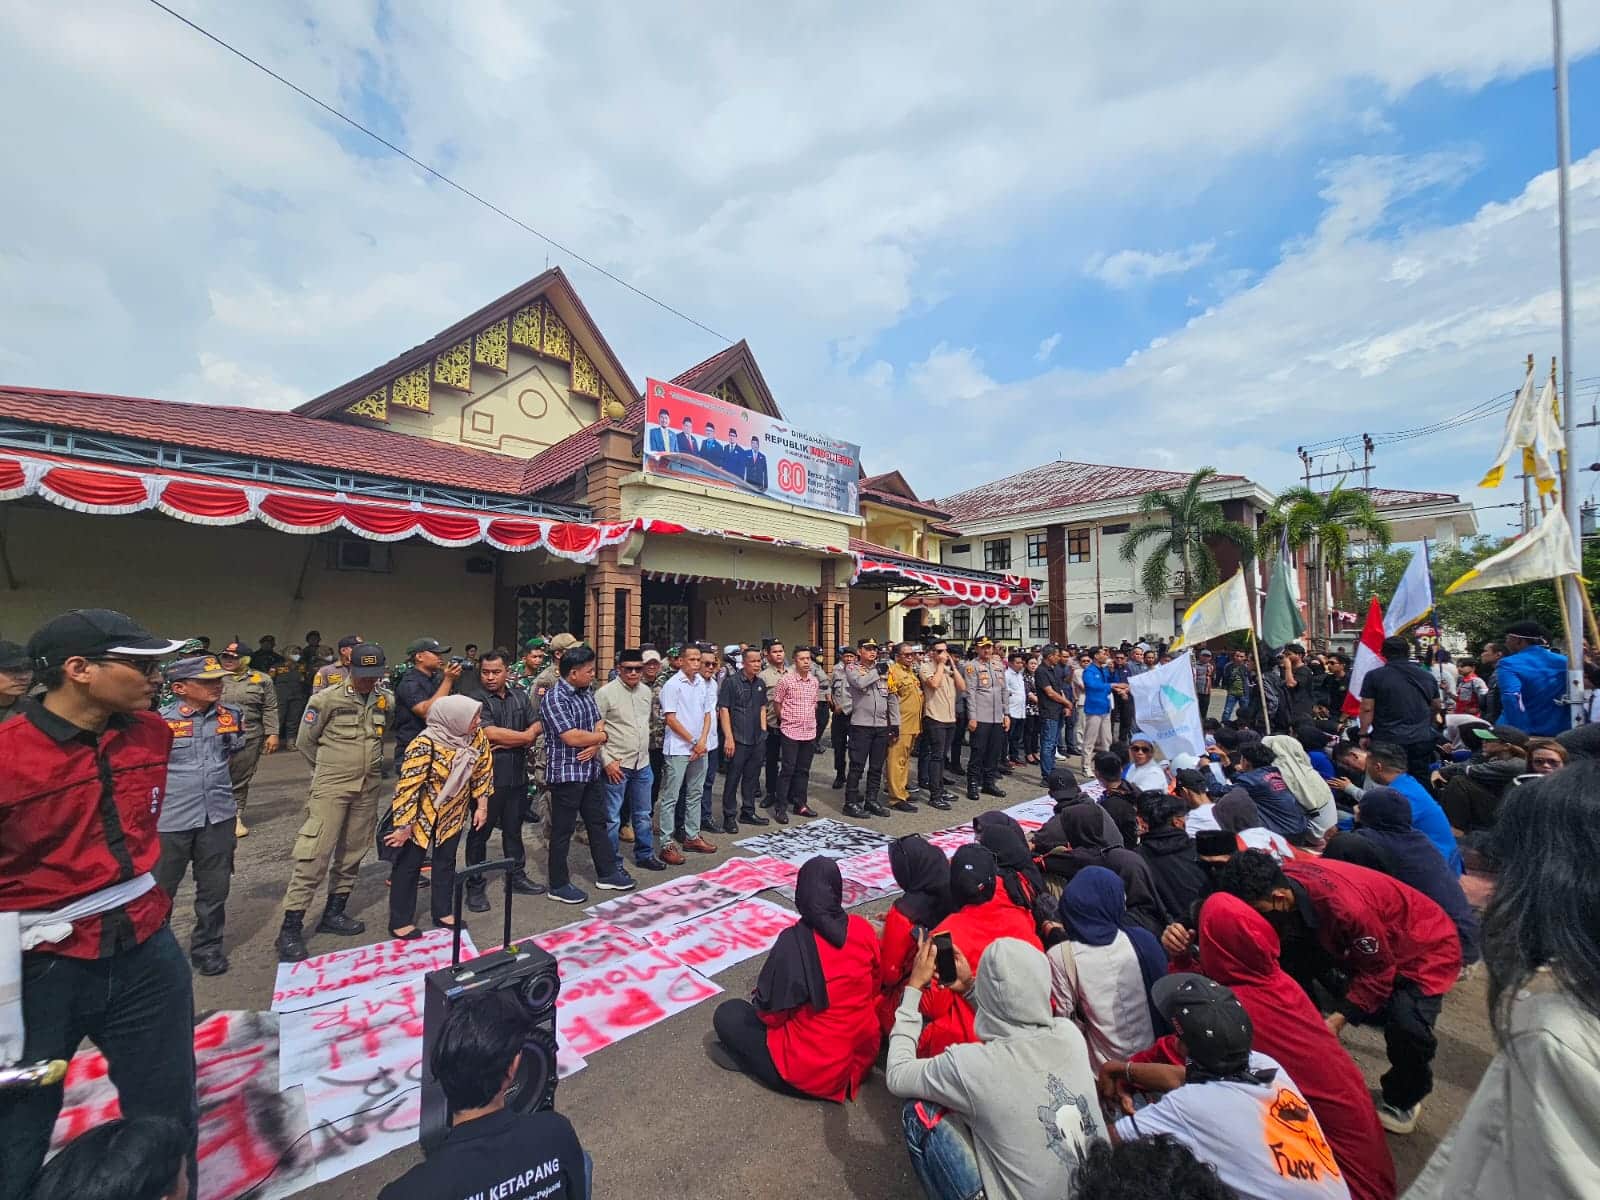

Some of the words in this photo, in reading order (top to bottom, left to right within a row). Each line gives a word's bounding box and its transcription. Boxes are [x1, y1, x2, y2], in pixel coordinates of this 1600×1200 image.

[764, 433, 808, 454] REPUBLIK
[809, 446, 854, 467] INDONESIA
[791, 430, 832, 448] DIRGAHAYU
[777, 458, 807, 496] 80
[489, 1158, 560, 1200] KETAPANG
